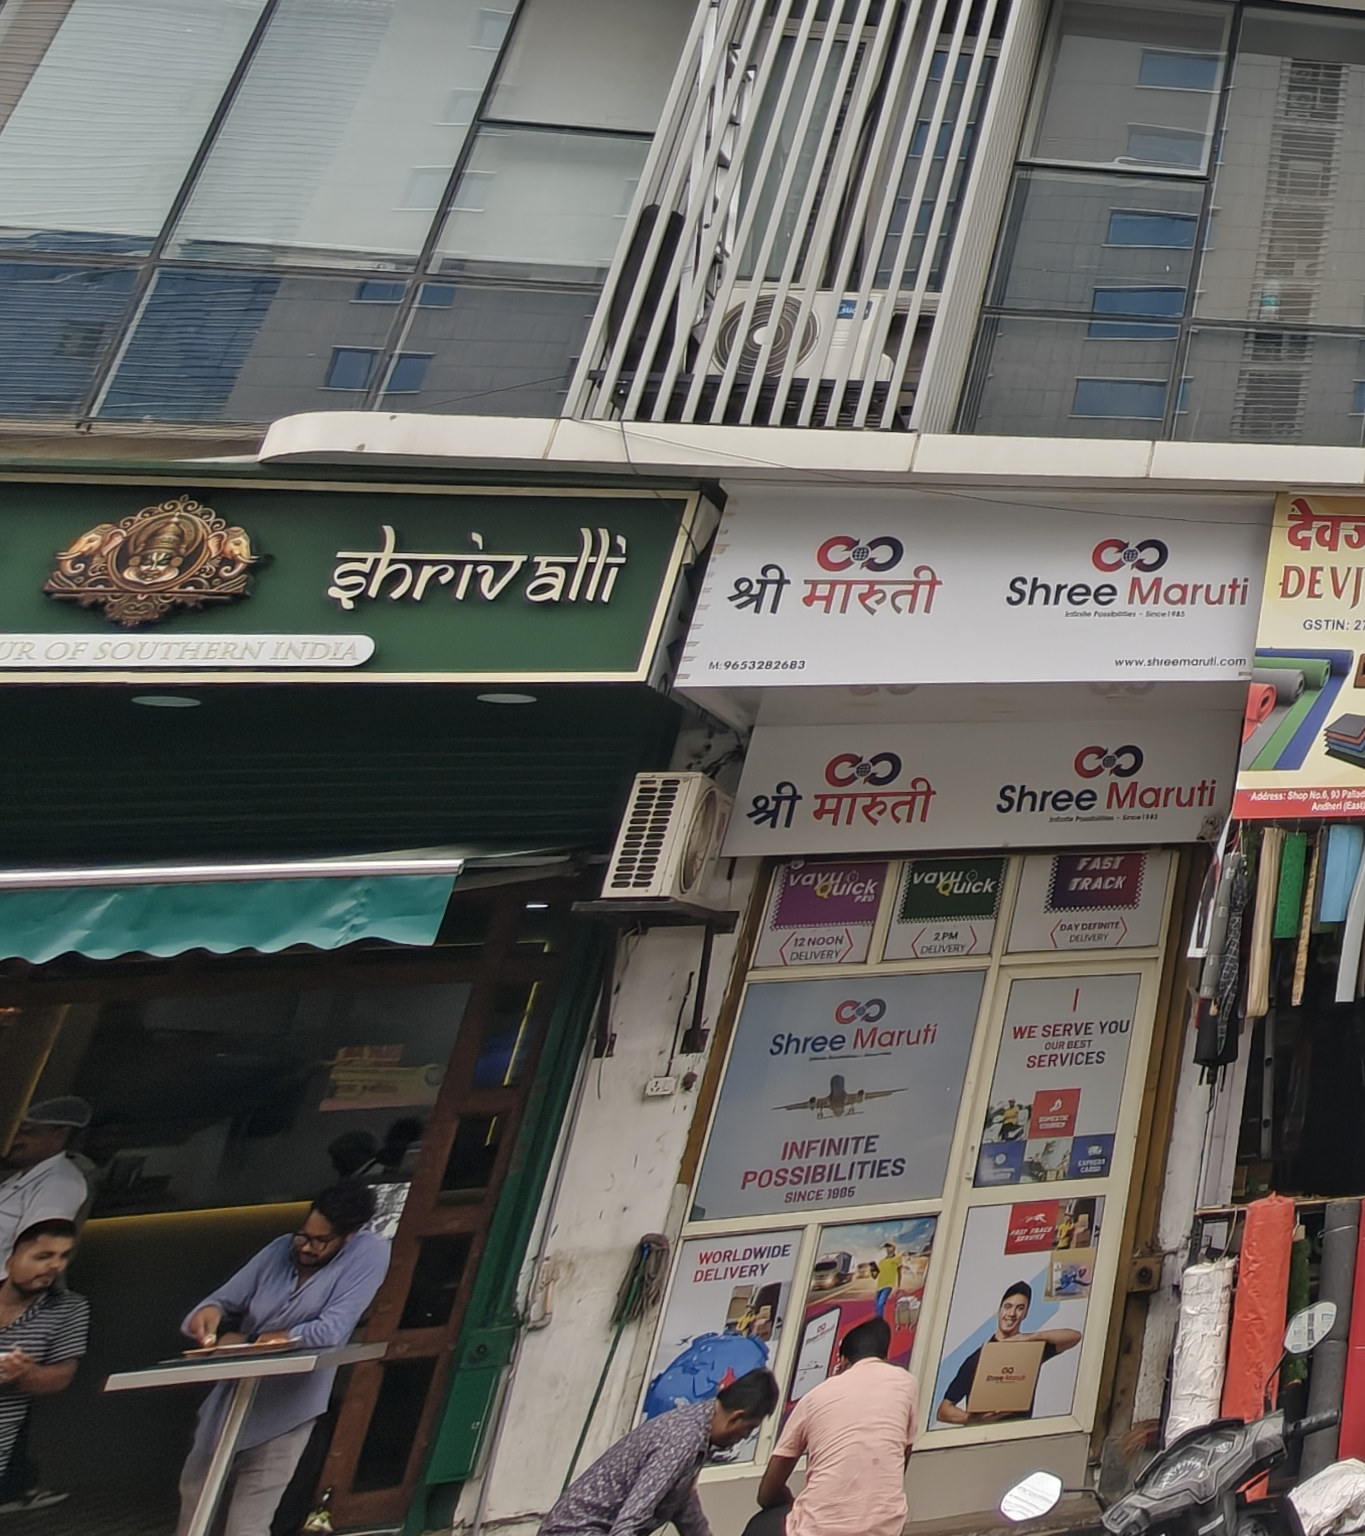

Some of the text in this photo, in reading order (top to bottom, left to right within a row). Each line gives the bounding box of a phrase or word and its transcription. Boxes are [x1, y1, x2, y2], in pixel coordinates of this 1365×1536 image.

[727, 563, 944, 616] श्री मारुती
[1006, 575, 1251, 607] Shree Maruti
[1302, 618, 1350, 632] GSTIN:
[43, 641, 88, 661] OF
[91, 640, 262, 662] SOUTHERN
[270, 641, 360, 662] INDIA
[1113, 656, 1248, 668] www.shreemaruti.com
[745, 776, 937, 830] श्री मारुती
[996, 779, 1218, 814] Shree Maruti
[1068, 875, 1128, 892] TRACK
[1059, 920, 1121, 932] DAY DEFINITE
[920, 942, 967, 955] DELIVERY
[1068, 932, 1110, 944] DELIVERY
[789, 948, 843, 962] DELIVERY
[769, 1023, 939, 1056] Shree Maruti
[1012, 1019, 1131, 1040] WE SERVE YOU
[1044, 1039, 1094, 1051] OUR BEST
[1026, 1050, 1106, 1069] SERVICES
[780, 1134, 880, 1162] INFINITE
[740, 1157, 907, 1191] POSSIBILITIES
[697, 1244, 792, 1266] WORLDWIDE
[693, 1262, 770, 1283] DELIVERY
